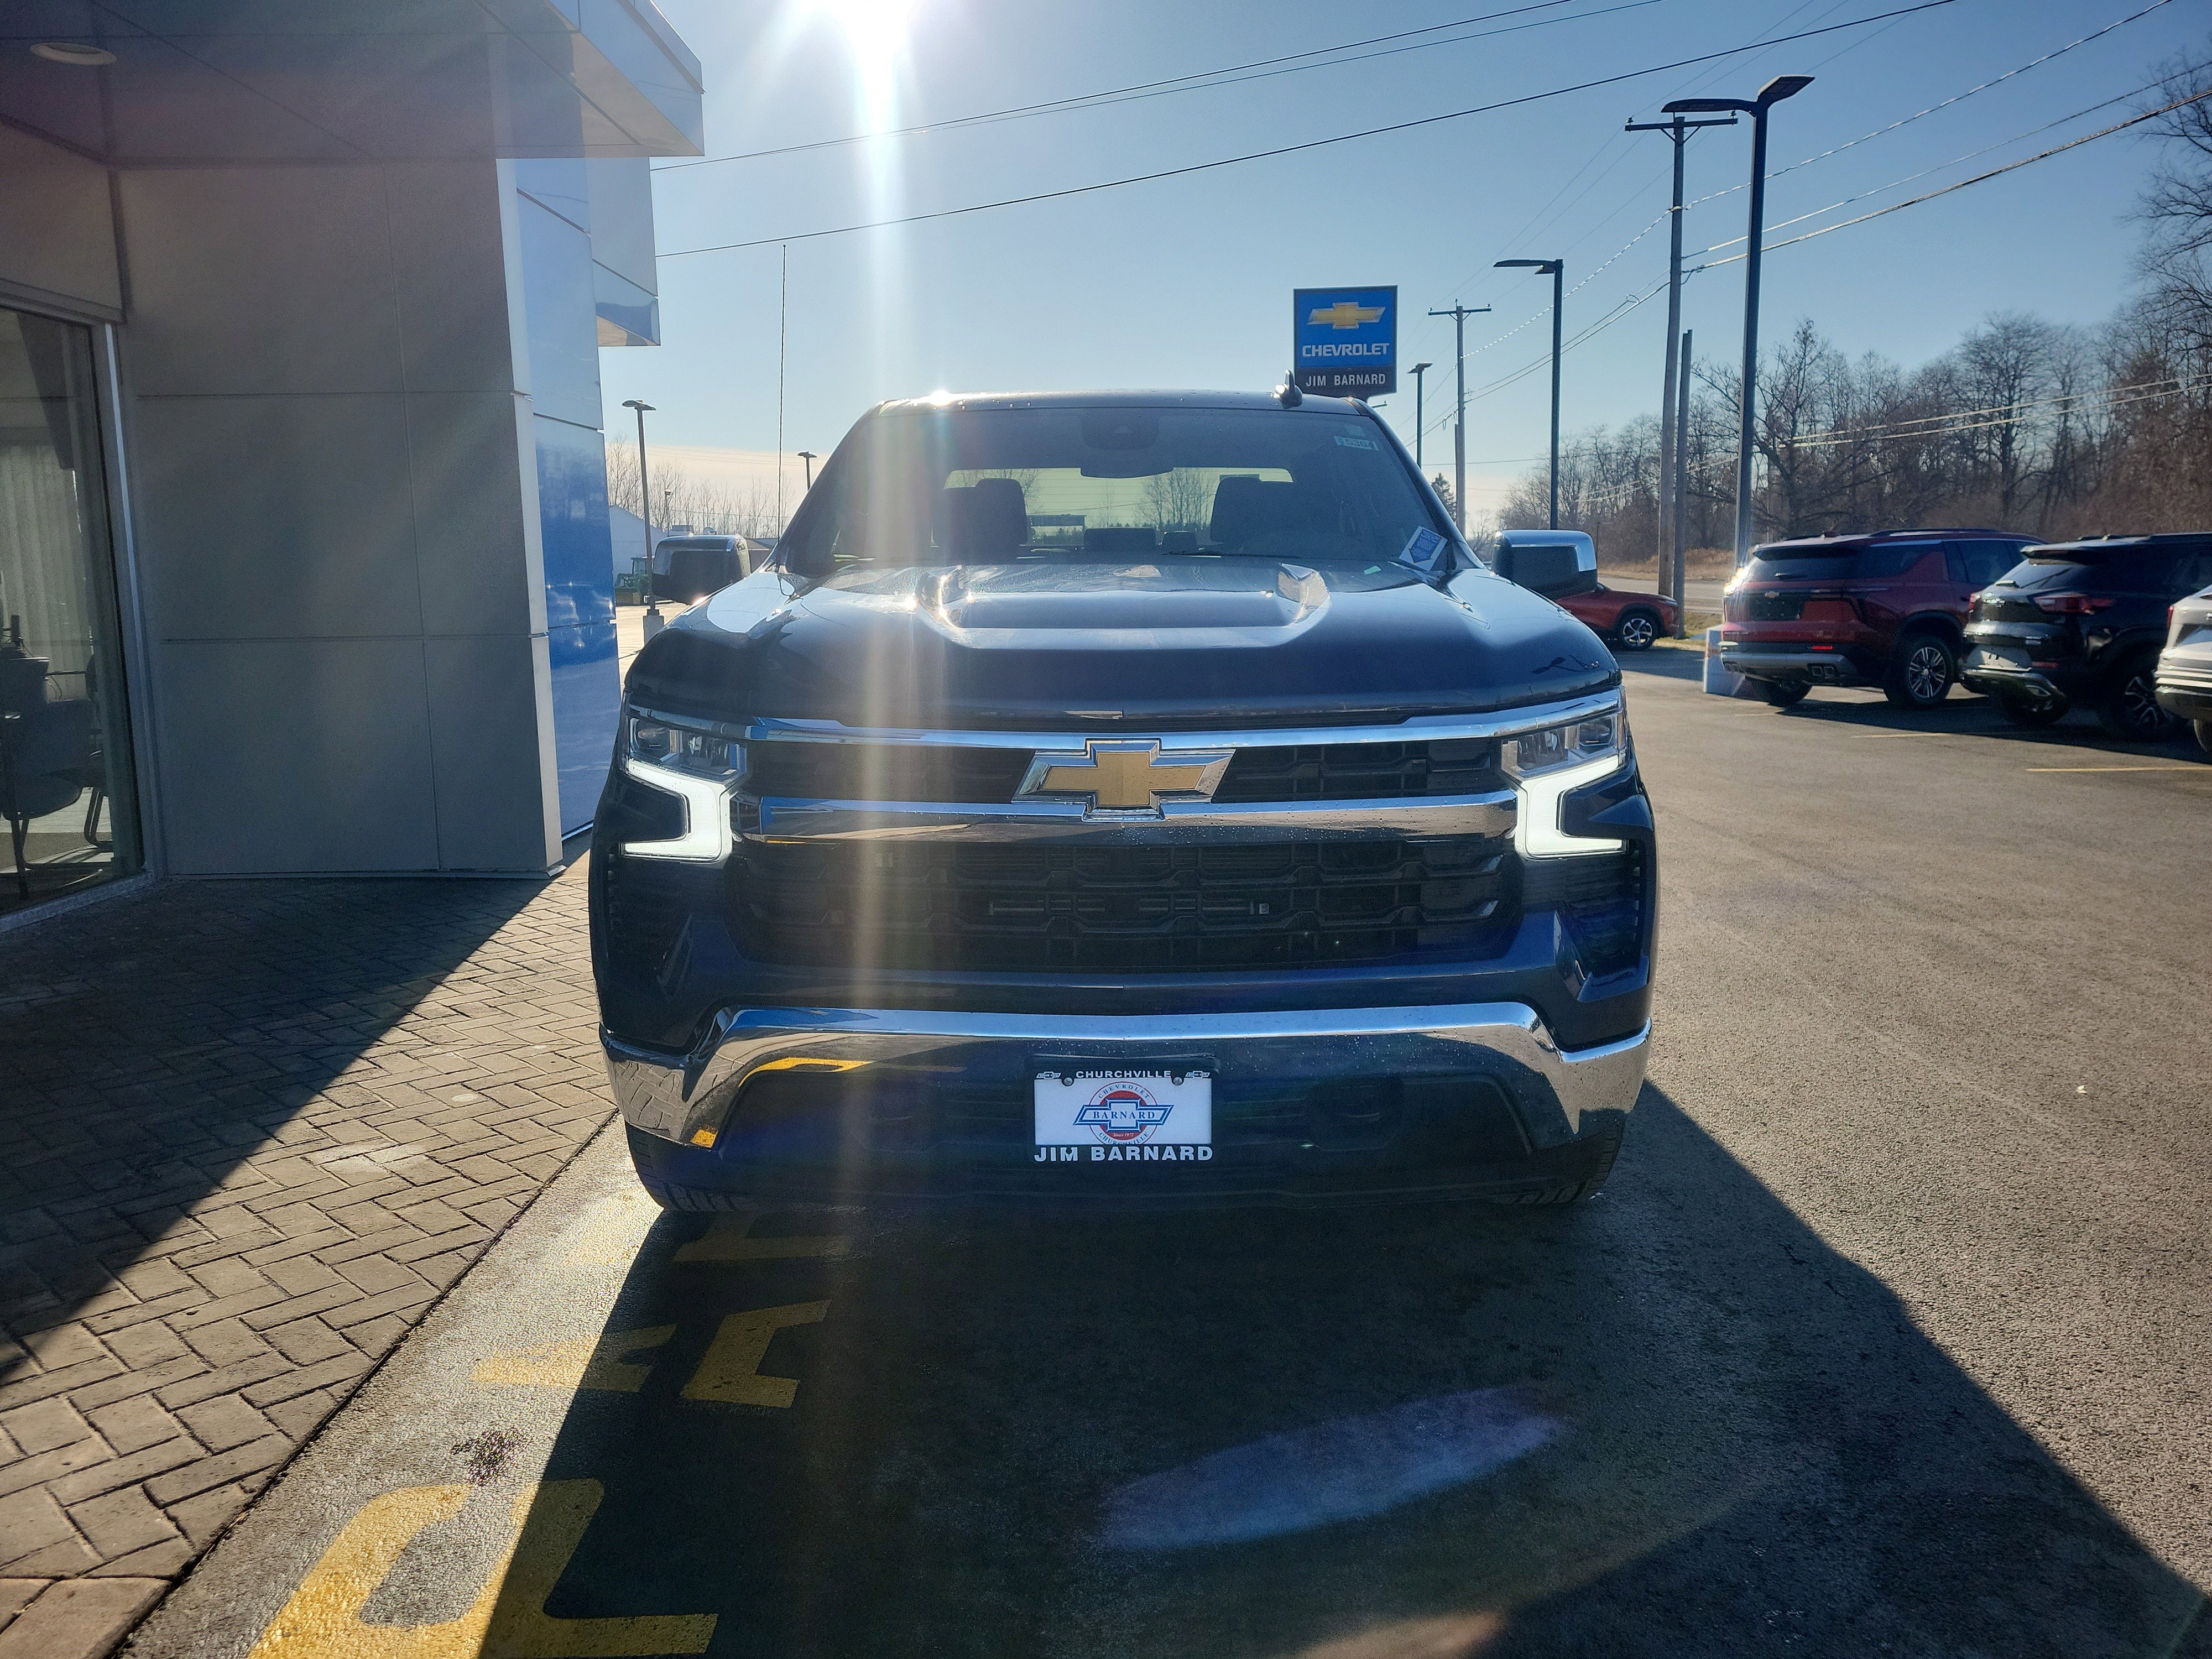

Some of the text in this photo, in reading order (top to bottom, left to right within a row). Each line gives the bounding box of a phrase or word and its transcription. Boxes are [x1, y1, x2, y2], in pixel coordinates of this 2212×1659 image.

[1302, 342, 1390, 357] CHEVROLET
[1306, 373, 1386, 387] JIM BARNARD
[1076, 1070, 1172, 1078] CHURCHVILLE
[1098, 1084, 1150, 1098] CHEVROLET
[1093, 1111, 1155, 1119] BARNARD
[1034, 1146, 1213, 1162] JIM BARNARD
